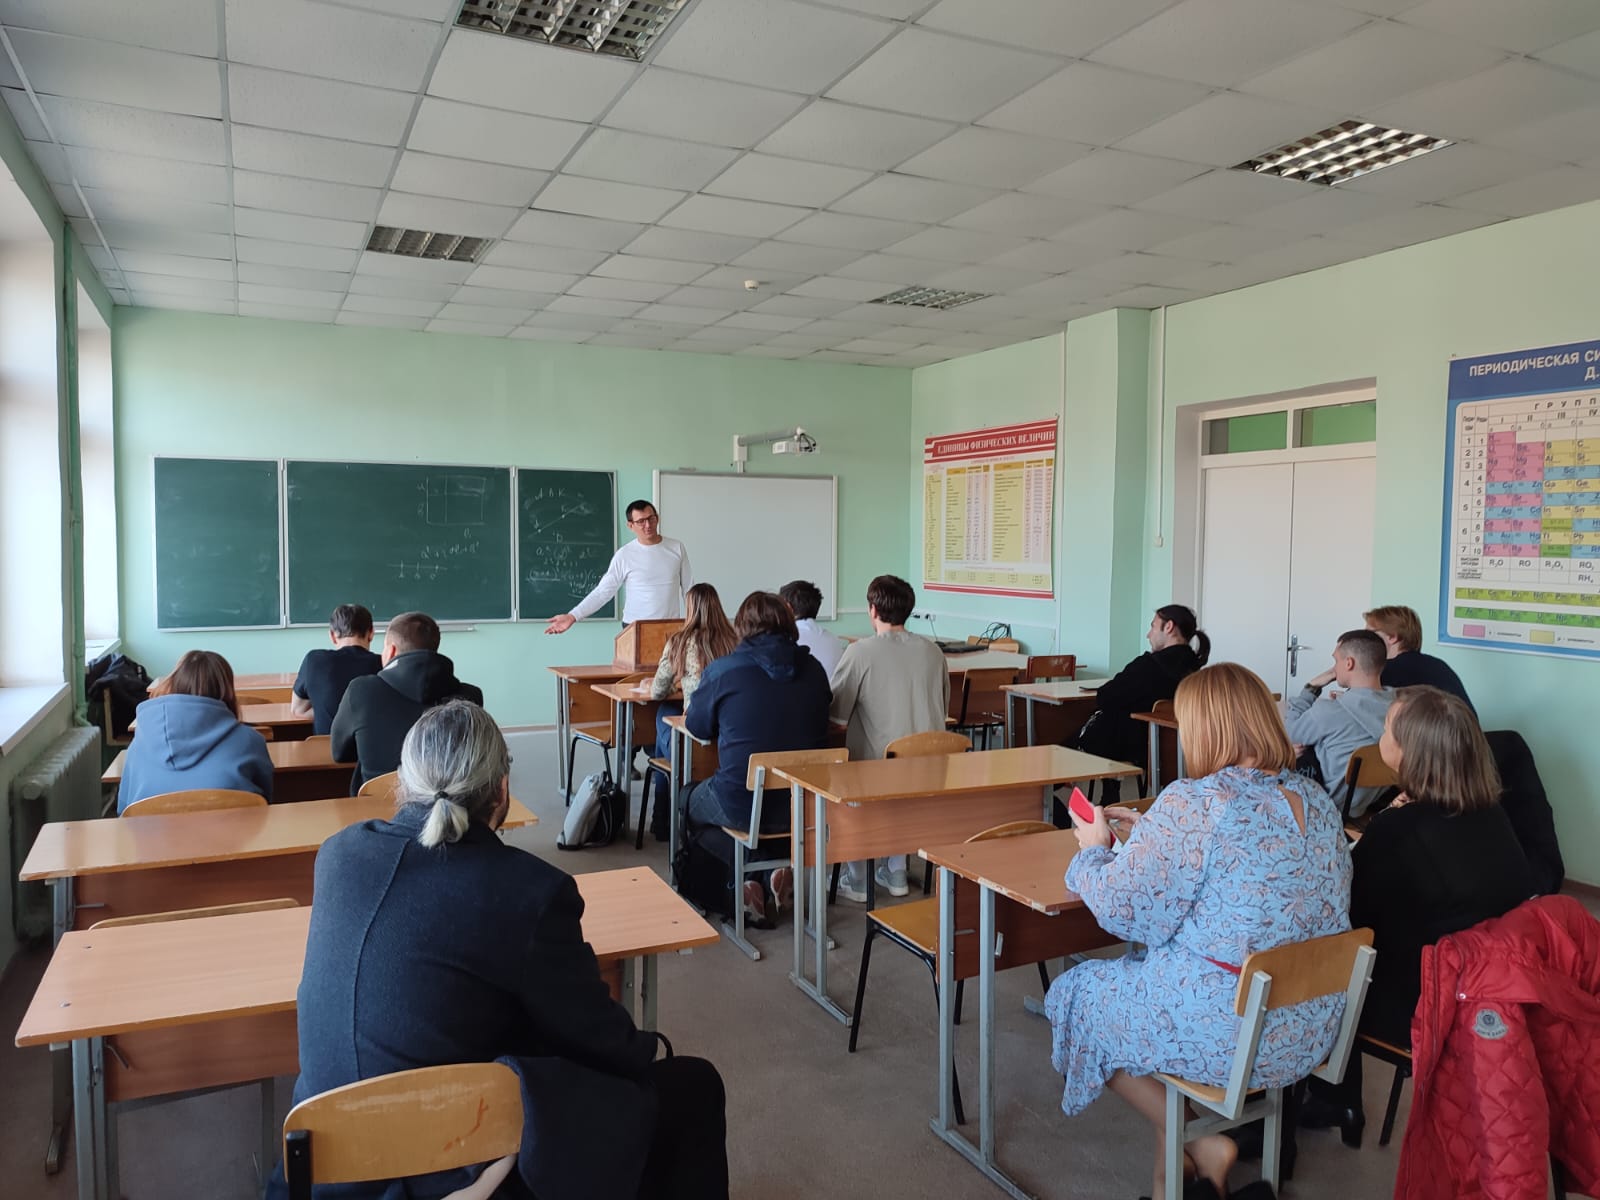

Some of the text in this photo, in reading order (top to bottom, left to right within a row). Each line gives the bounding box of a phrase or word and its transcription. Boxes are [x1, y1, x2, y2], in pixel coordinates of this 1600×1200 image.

[1469, 351, 1580, 377] ПЕРИОДИЧЕСКАЯ
[970, 435, 1017, 450] ФИЗИЧЕСКИХ
[1018, 430, 1055, 444] ВЕЛИЧИН
